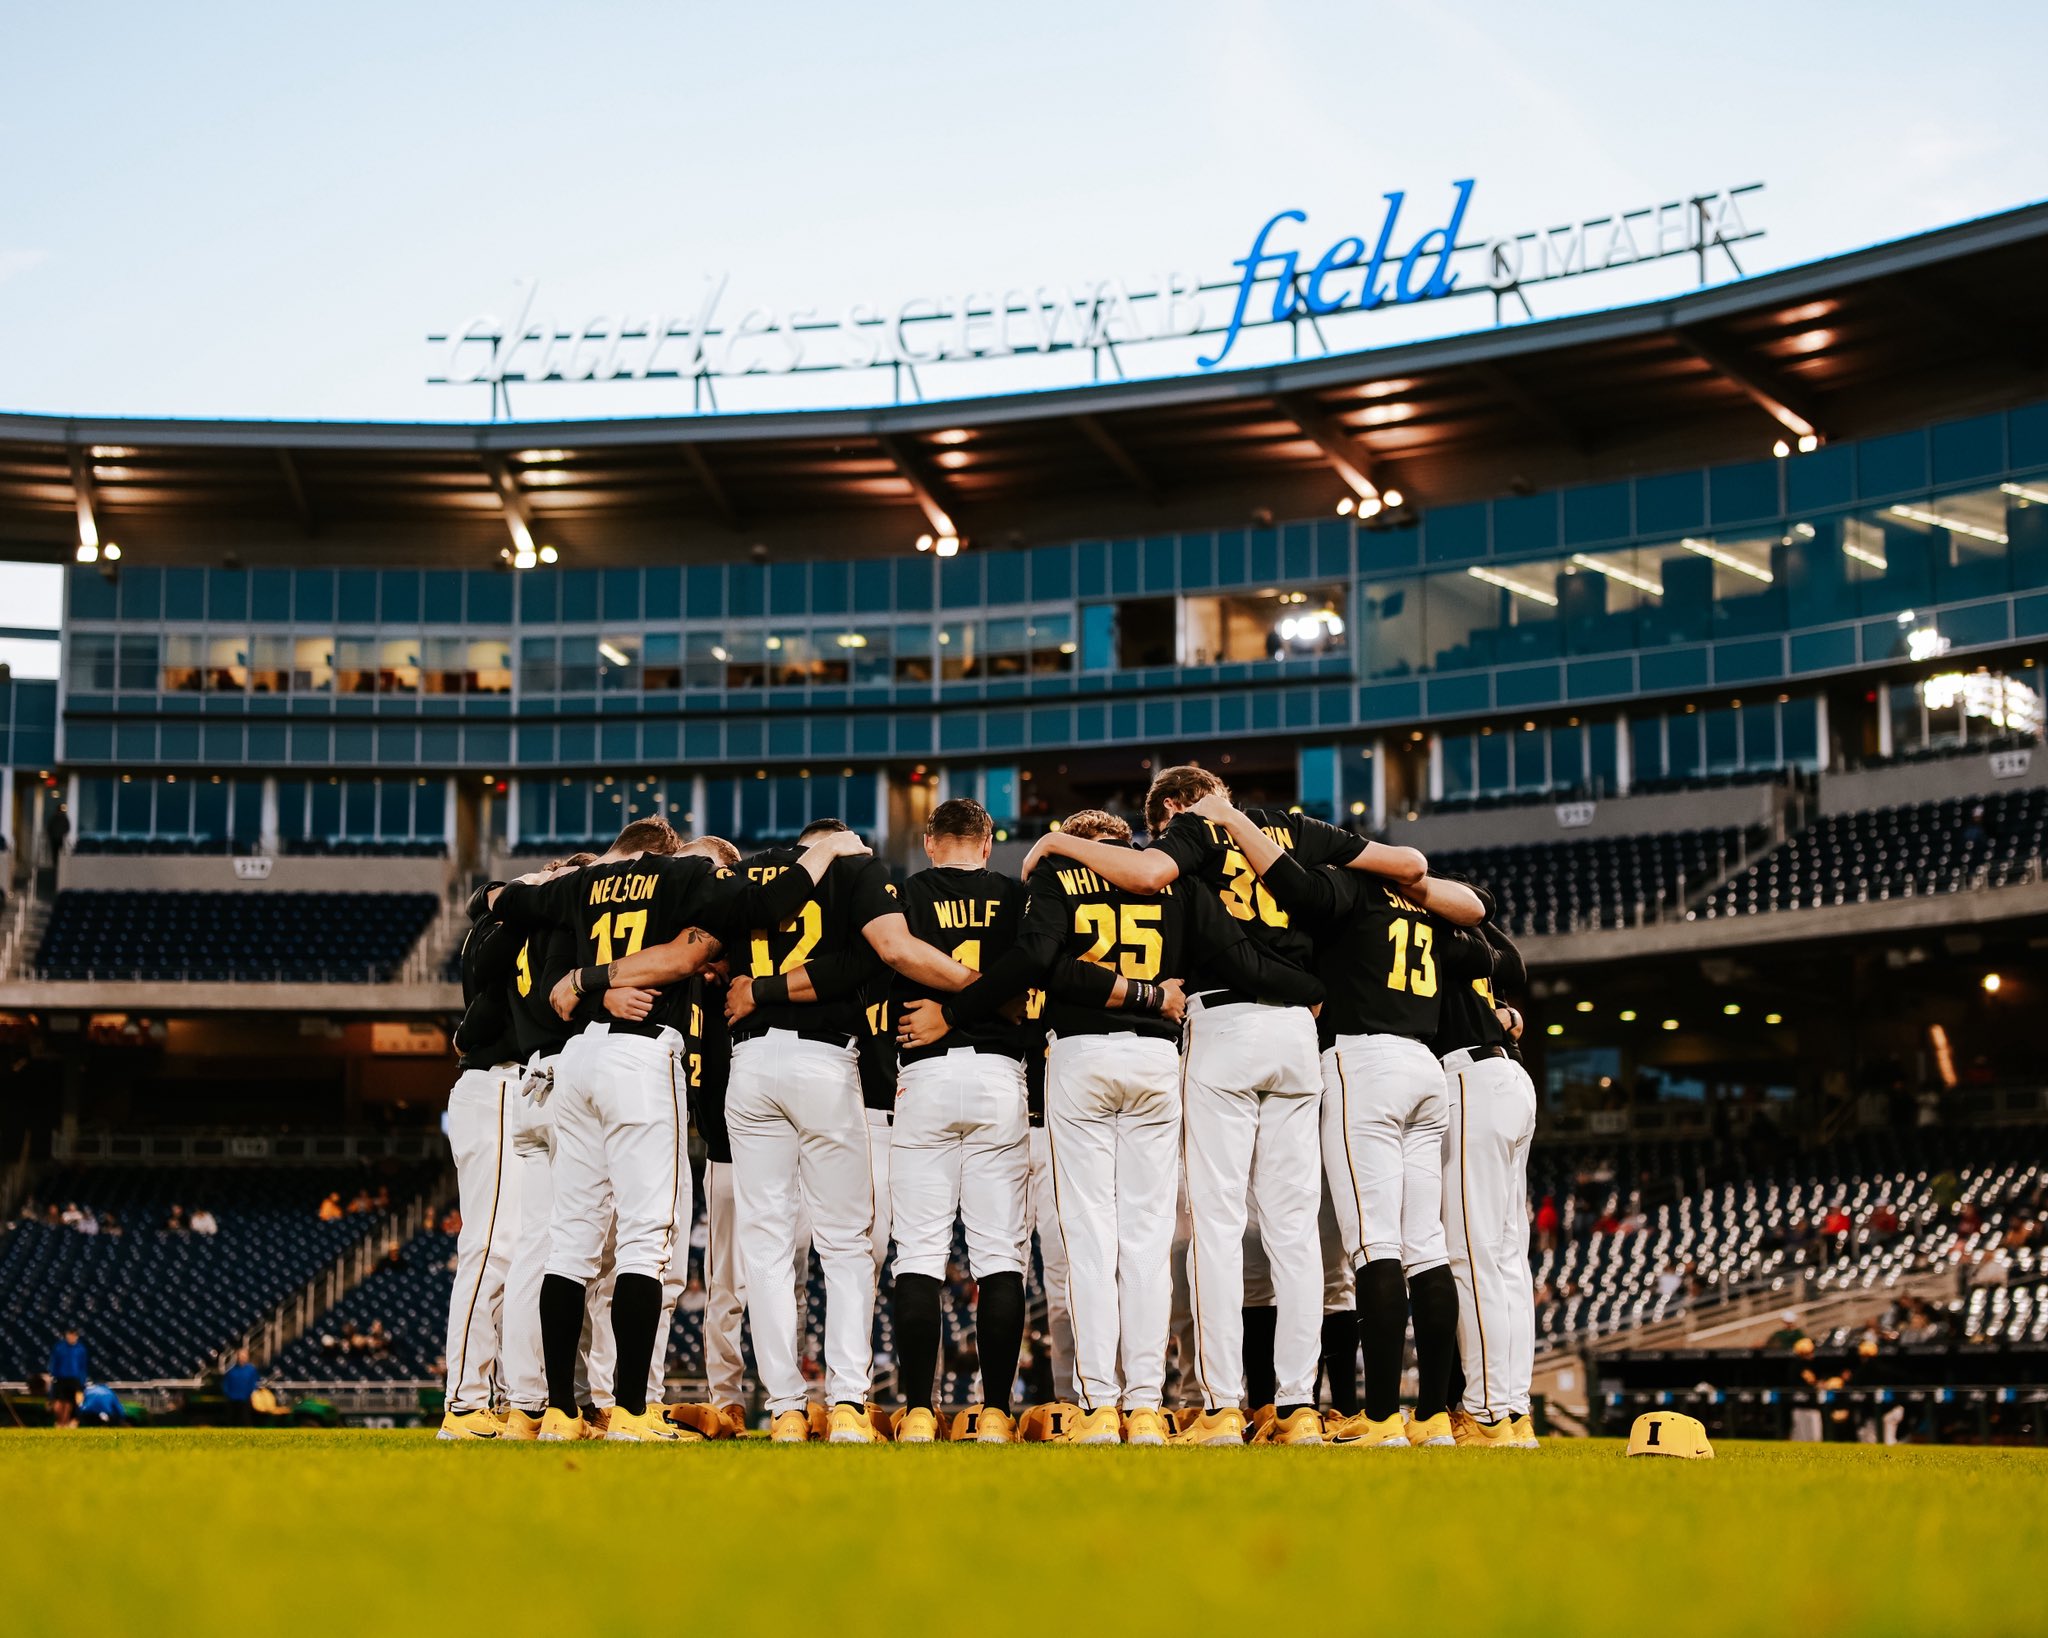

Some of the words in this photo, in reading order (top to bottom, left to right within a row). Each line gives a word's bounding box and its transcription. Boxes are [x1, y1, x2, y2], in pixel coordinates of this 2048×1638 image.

[1197, 179, 1475, 366] field
[1484, 190, 1748, 290] OMAHA
[590, 873, 659, 906] NELSON
[933, 899, 1000, 929] WULF
[590, 909, 648, 966] 17
[1075, 903, 1163, 980] 25
[1388, 917, 1437, 998] 13
[966, 1413, 979, 1434] I
[1051, 1412, 1063, 1435] I
[1646, 1421, 1662, 1446] I
